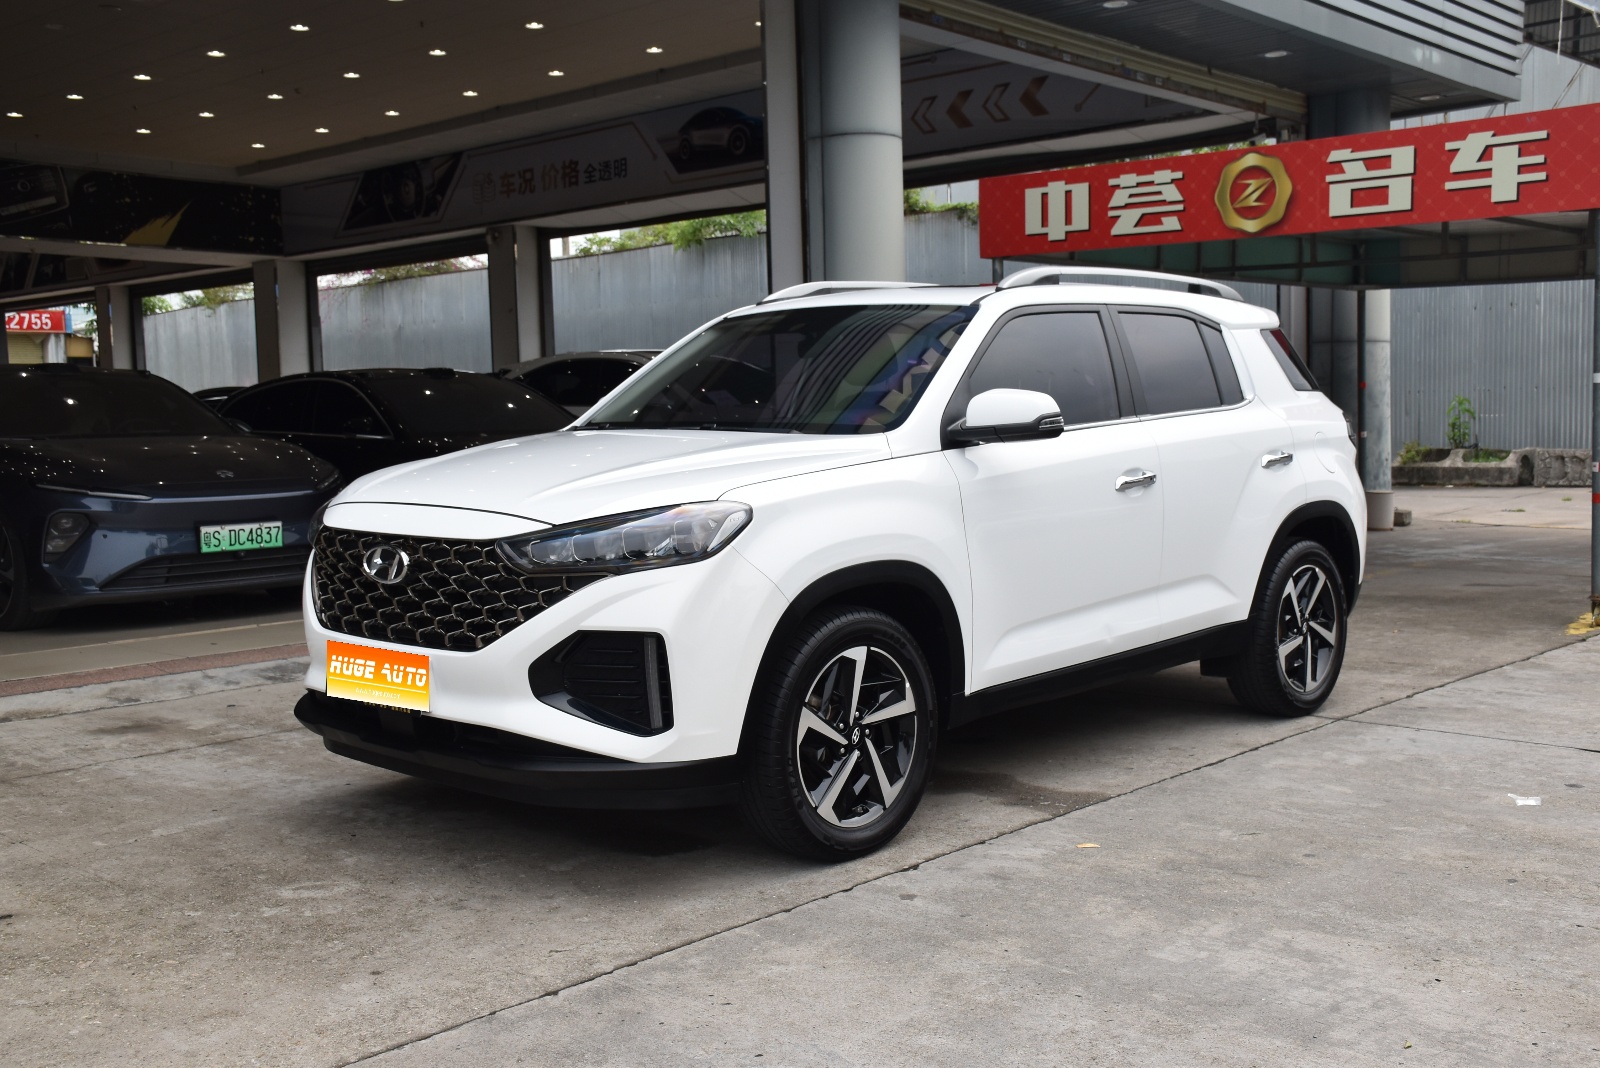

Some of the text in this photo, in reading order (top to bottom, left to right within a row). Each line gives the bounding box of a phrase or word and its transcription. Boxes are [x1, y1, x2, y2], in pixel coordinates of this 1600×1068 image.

[499, 157, 627, 198] 车况 价格 全透明
[1024, 169, 1185, 241] 中荟
[1325, 129, 1549, 218] 名车
